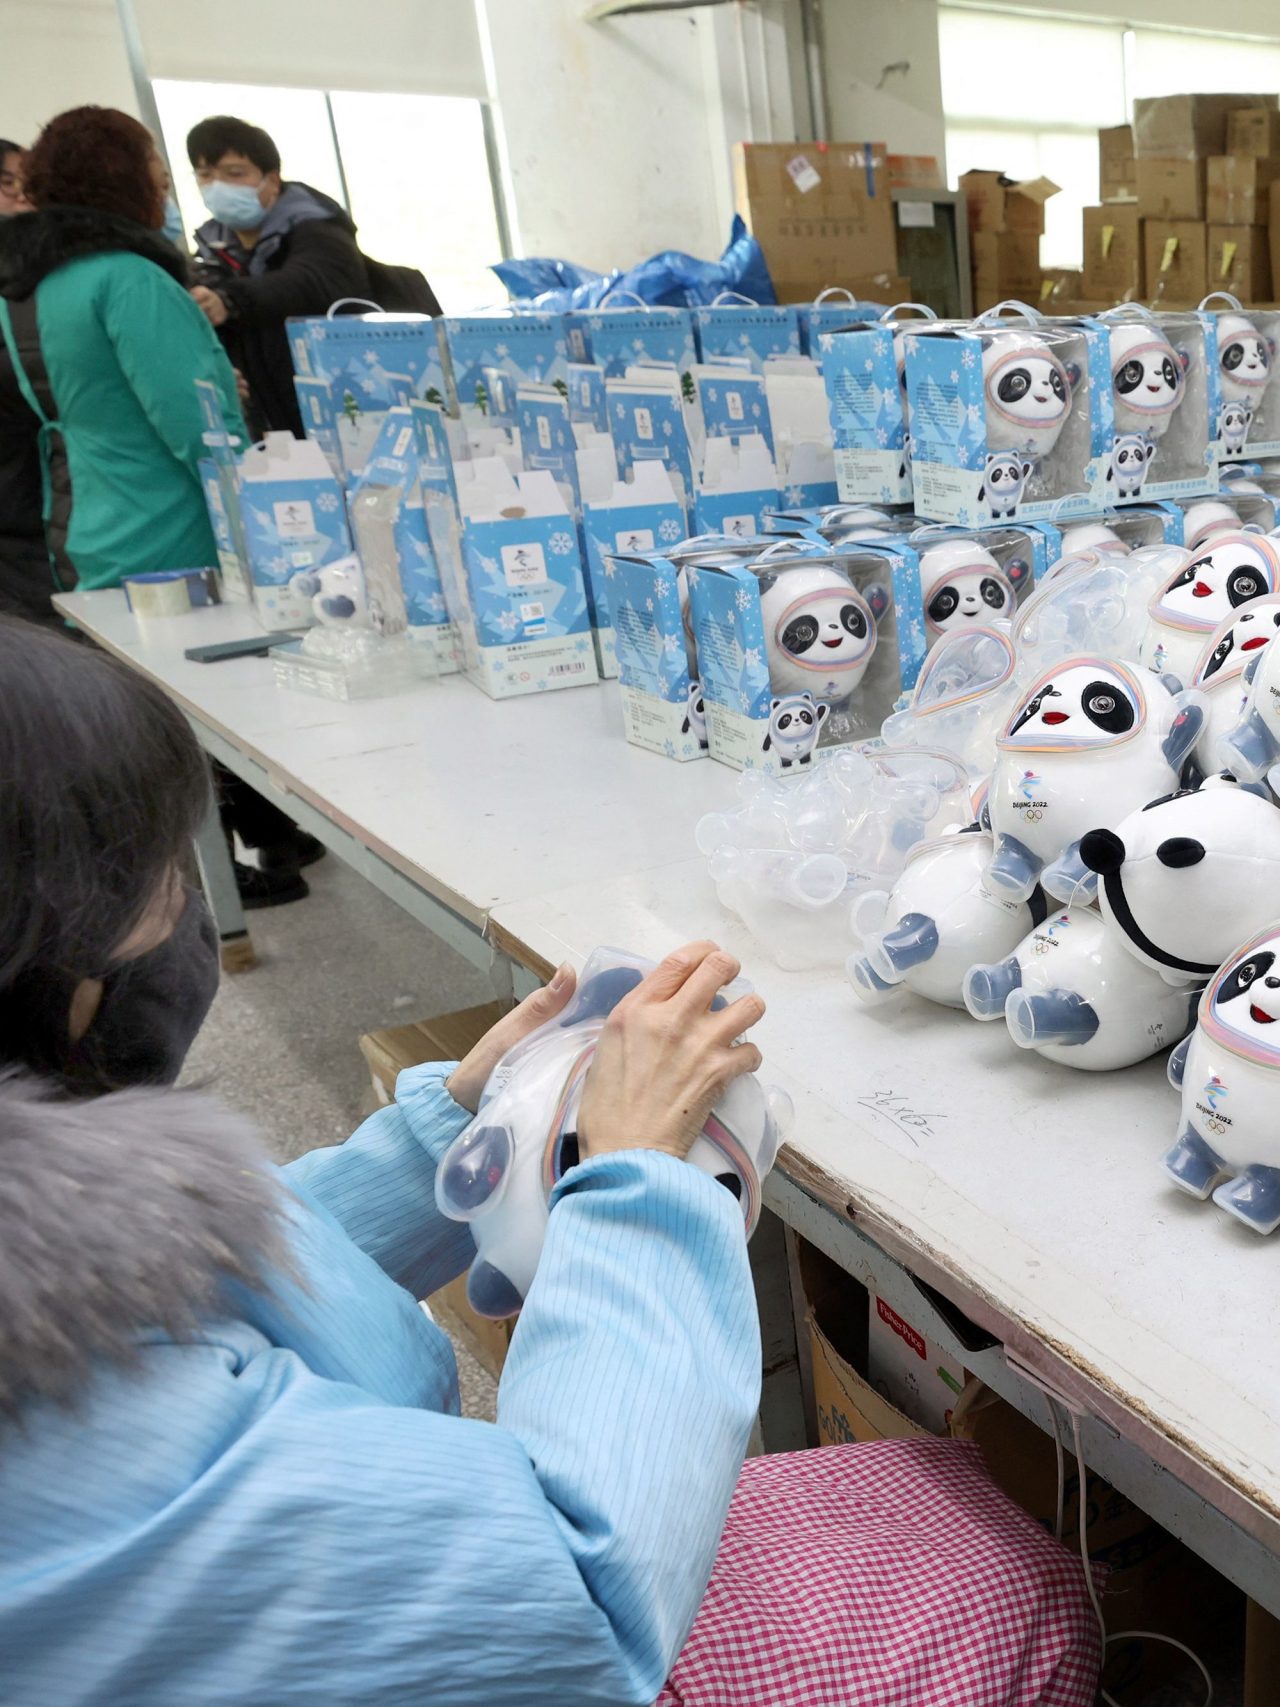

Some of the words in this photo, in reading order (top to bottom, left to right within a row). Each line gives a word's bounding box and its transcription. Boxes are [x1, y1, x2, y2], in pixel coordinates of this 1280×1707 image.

[1012, 801, 1031, 809] BEIJING
[1195, 1102, 1215, 1118] BEIJING
[1215, 1113, 1233, 1126] 2022
